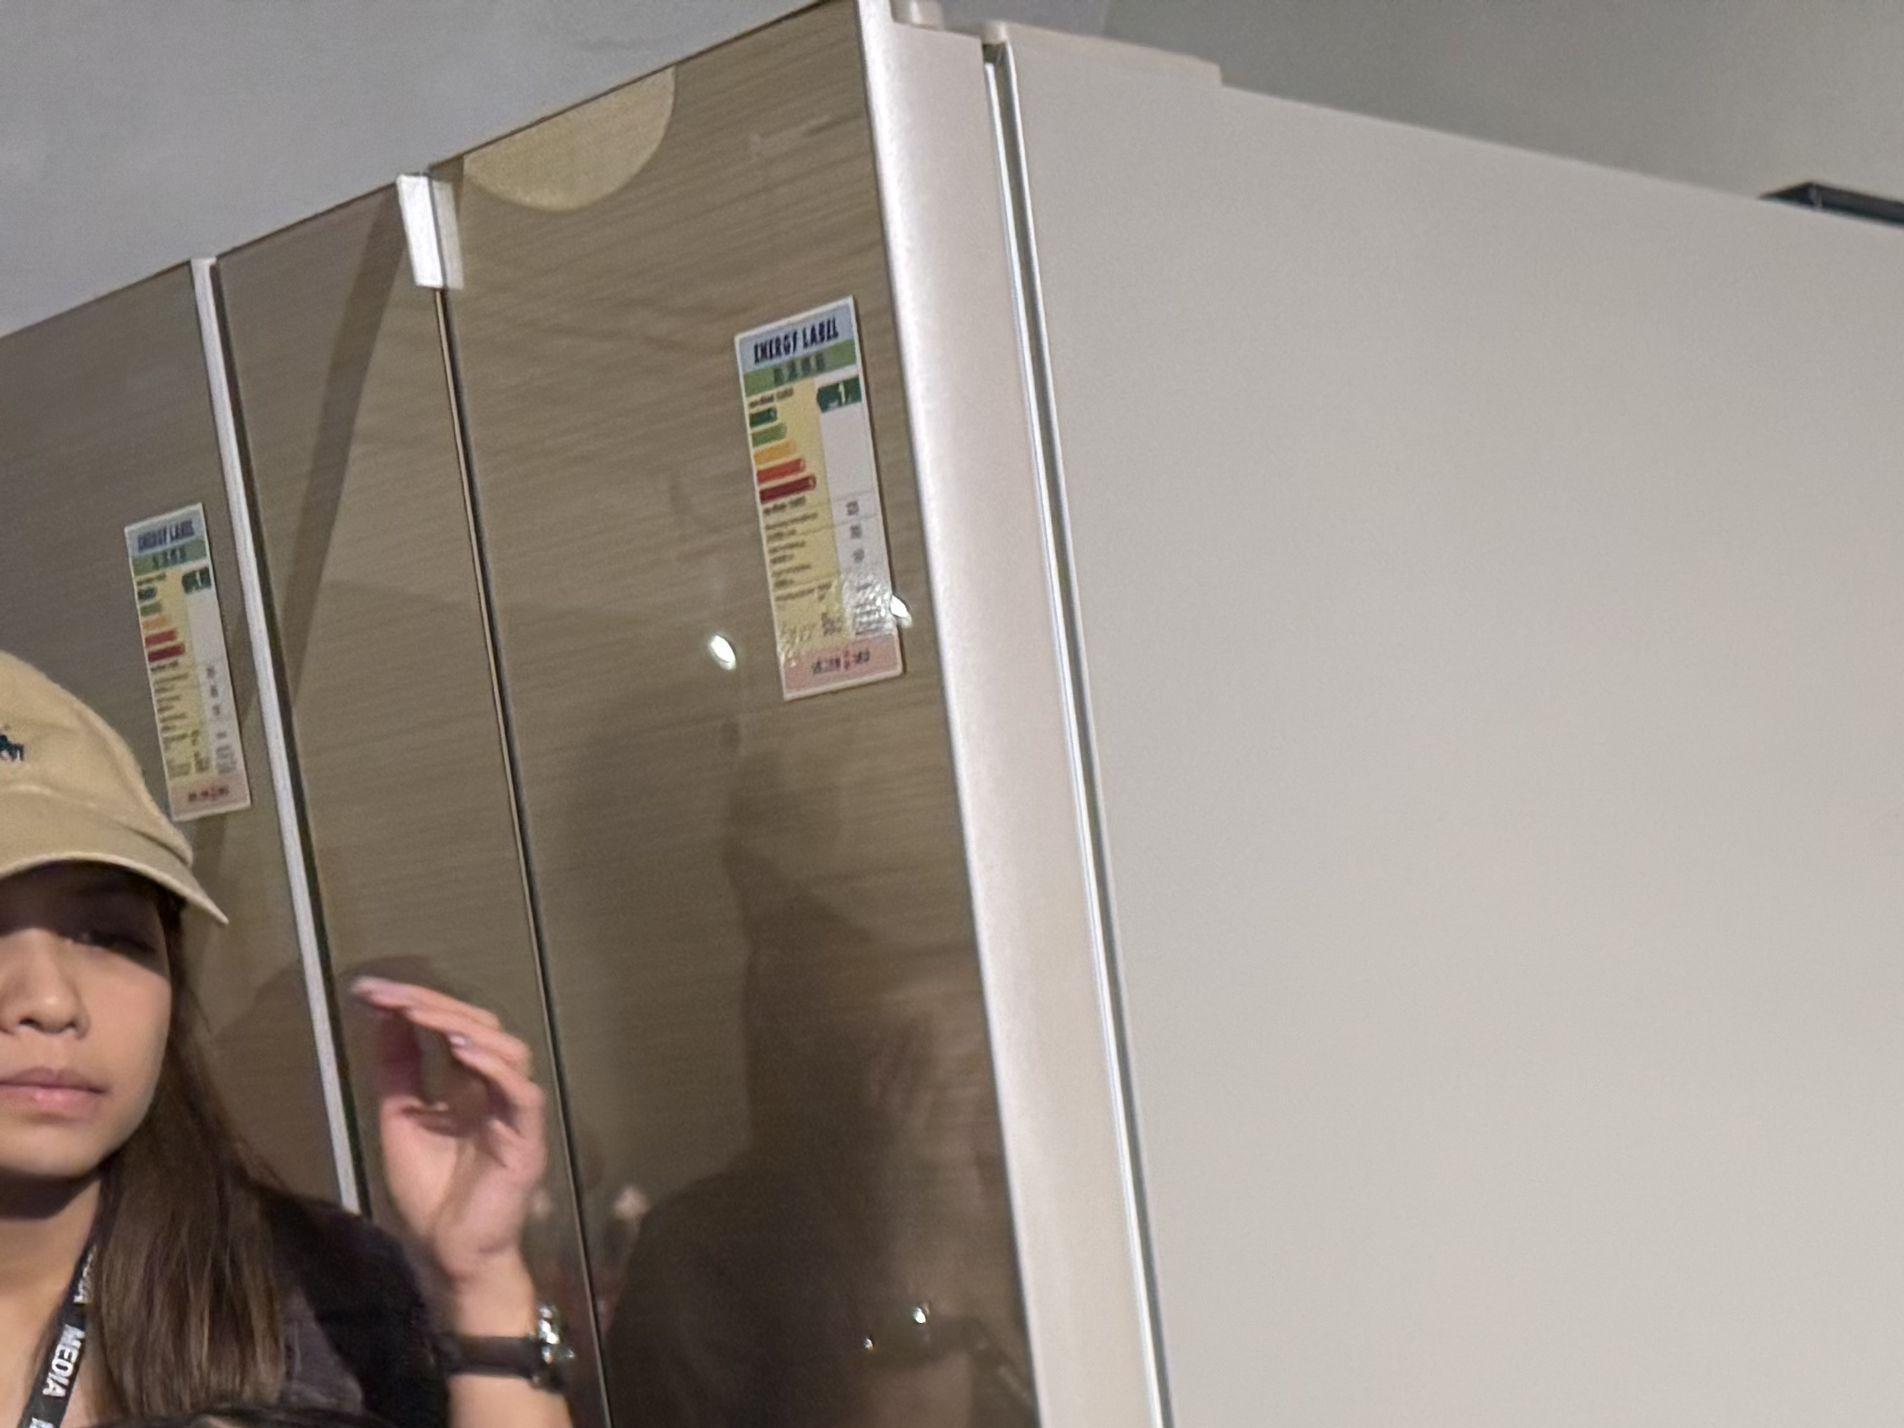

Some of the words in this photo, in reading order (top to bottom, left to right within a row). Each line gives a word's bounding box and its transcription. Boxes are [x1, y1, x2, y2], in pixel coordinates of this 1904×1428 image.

[753, 331, 798, 364] ENERGY
[802, 317, 839, 349] LABEL
[42, 1323, 86, 1399] MEDIA
